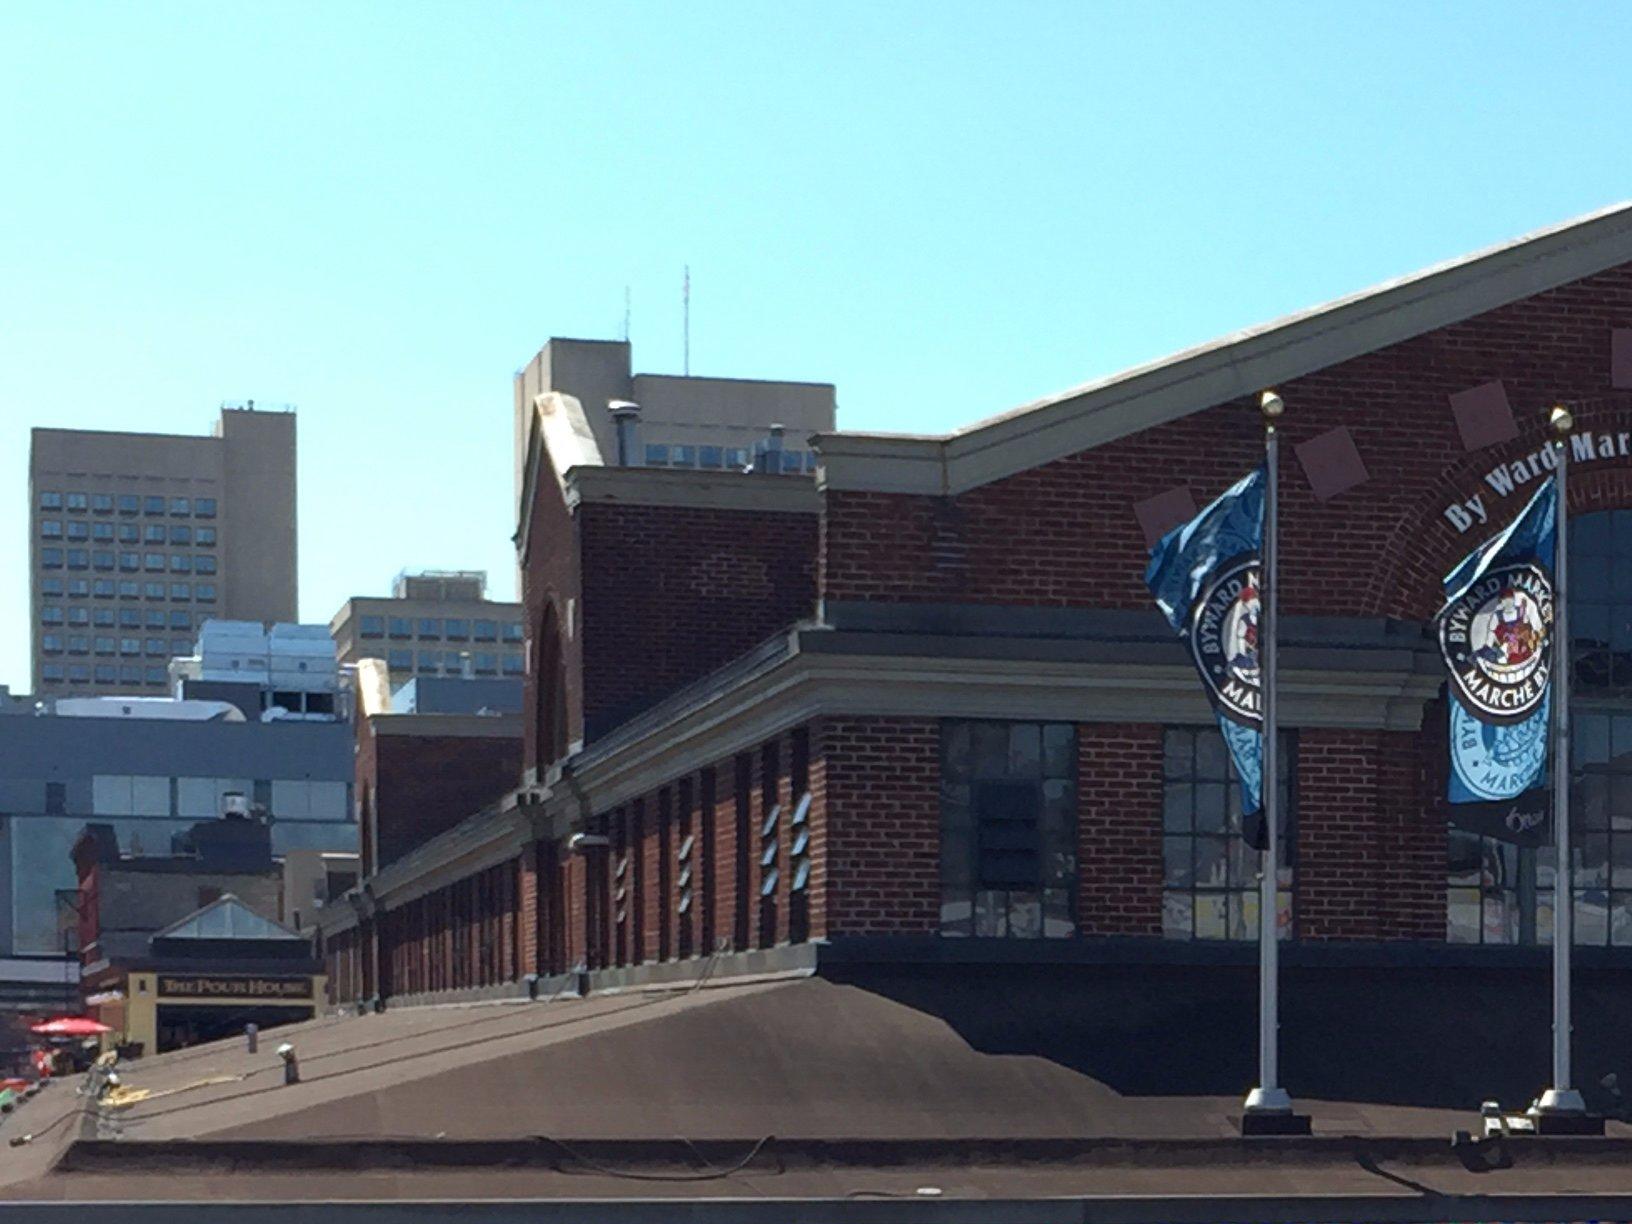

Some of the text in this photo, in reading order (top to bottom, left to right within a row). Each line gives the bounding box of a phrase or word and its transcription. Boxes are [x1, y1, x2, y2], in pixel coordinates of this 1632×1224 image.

[1444, 492, 1491, 534] By
[1485, 439, 1559, 498] Ward
[198, 979, 247, 993] POUR
